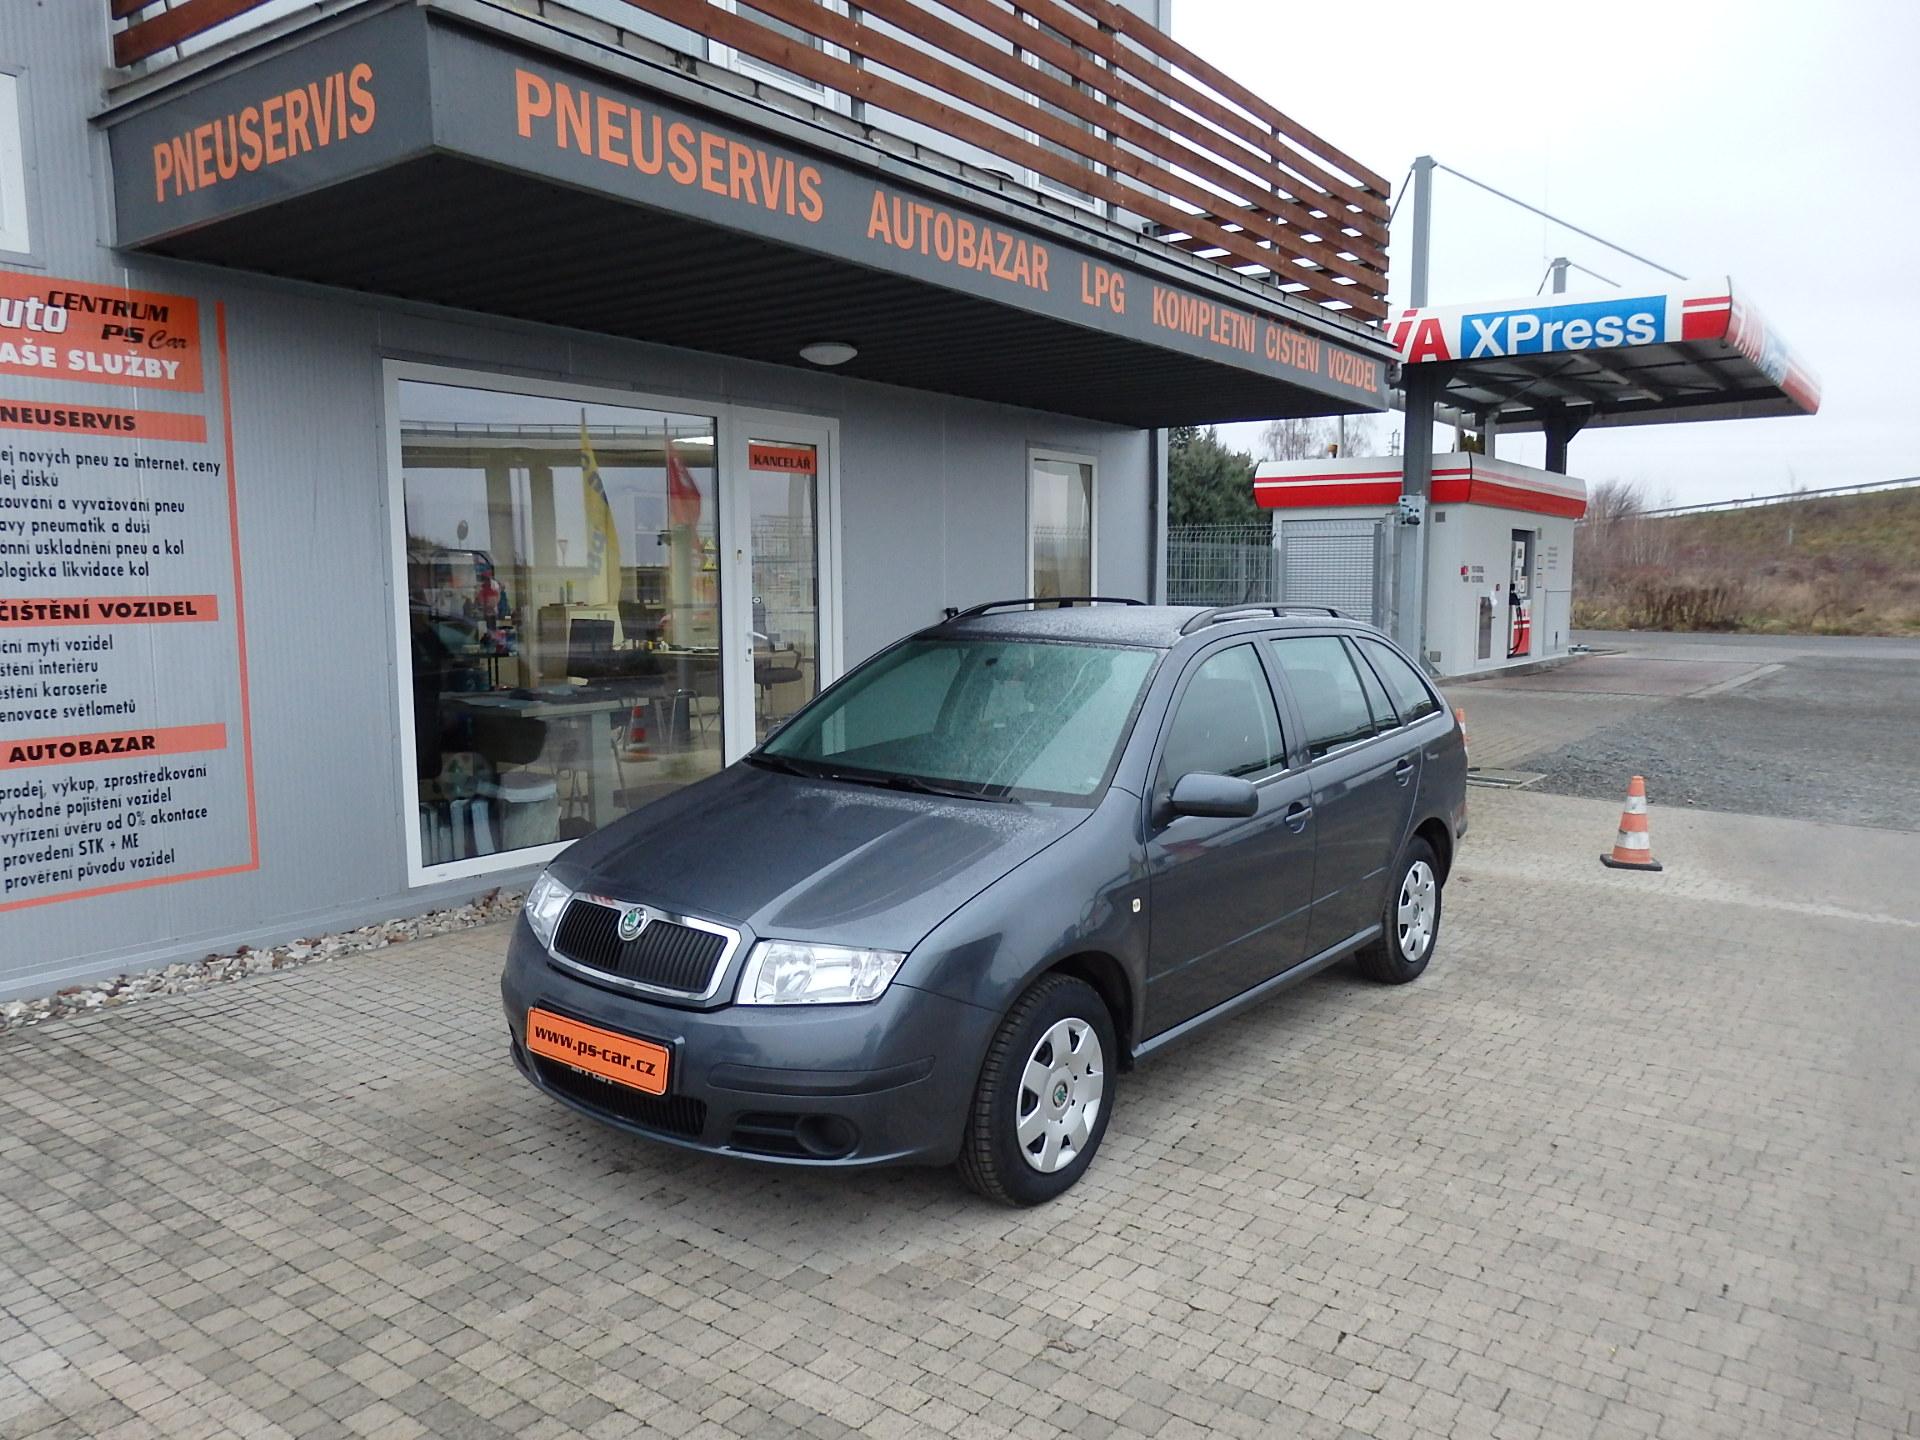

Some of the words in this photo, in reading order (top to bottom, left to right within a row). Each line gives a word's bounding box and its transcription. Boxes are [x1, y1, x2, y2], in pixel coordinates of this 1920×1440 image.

[153, 62, 376, 203] PNEUSERVIS
[515, 67, 824, 223] PNEUSERVIS
[867, 190, 1049, 292] AUTOBAZAR
[1081, 262, 1126, 313] LPG
[1153, 286, 1257, 353] KOMPLETNÍ
[1328, 347, 1377, 393] VOZIDEL
[48, 291, 169, 322] CENTRUM
[102, 324, 145, 343] PS
[148, 330, 187, 349] Car
[1470, 312, 1656, 359] XPress
[68, 349, 180, 380] SLUŽBY
[0, 445, 14, 466] ej
[19, 448, 70, 468] nových
[75, 453, 109, 469] pneu
[114, 456, 129, 468] za
[192, 461, 221, 477] ceny
[58, 499, 66, 510] a
[72, 497, 150, 514] vyvažování
[155, 501, 185, 516] pneu
[32, 516, 106, 536] pneumatik
[112, 522, 120, 533] a
[35, 538, 111, 555] uskladnění
[116, 544, 147, 558] pneu
[152, 544, 160, 555] a
[165, 538, 184, 555] kol
[62, 560, 124, 577] likvidace
[129, 560, 149, 577] kol
[0, 599, 90, 621] ČIŠTĚNÍ
[98, 601, 197, 618] VOZIDEL
[0, 639, 22, 654] ční
[65, 633, 113, 652] vozidel
[39, 658, 98, 676] interiéru
[43, 678, 108, 697] karoserie
[63, 699, 136, 720] světlometů
[9, 735, 155, 763] AUTOBAZAR
[104, 764, 207, 791] zprostředkování
[1, 801, 61, 826] výhodné
[127, 786, 172, 807] vozidel
[2, 824, 59, 848] vyřízení
[107, 813, 122, 830] od
[127, 810, 146, 828] 0%
[151, 807, 208, 825] akontace
[4, 845, 74, 872] provedení
[79, 838, 104, 856] STK
[121, 833, 139, 850] ME
[5, 867, 73, 894] prověření
[78, 857, 125, 881] původu
[130, 848, 175, 870] vozidel
[534, 1025, 656, 1077] www.ps-car.cz
